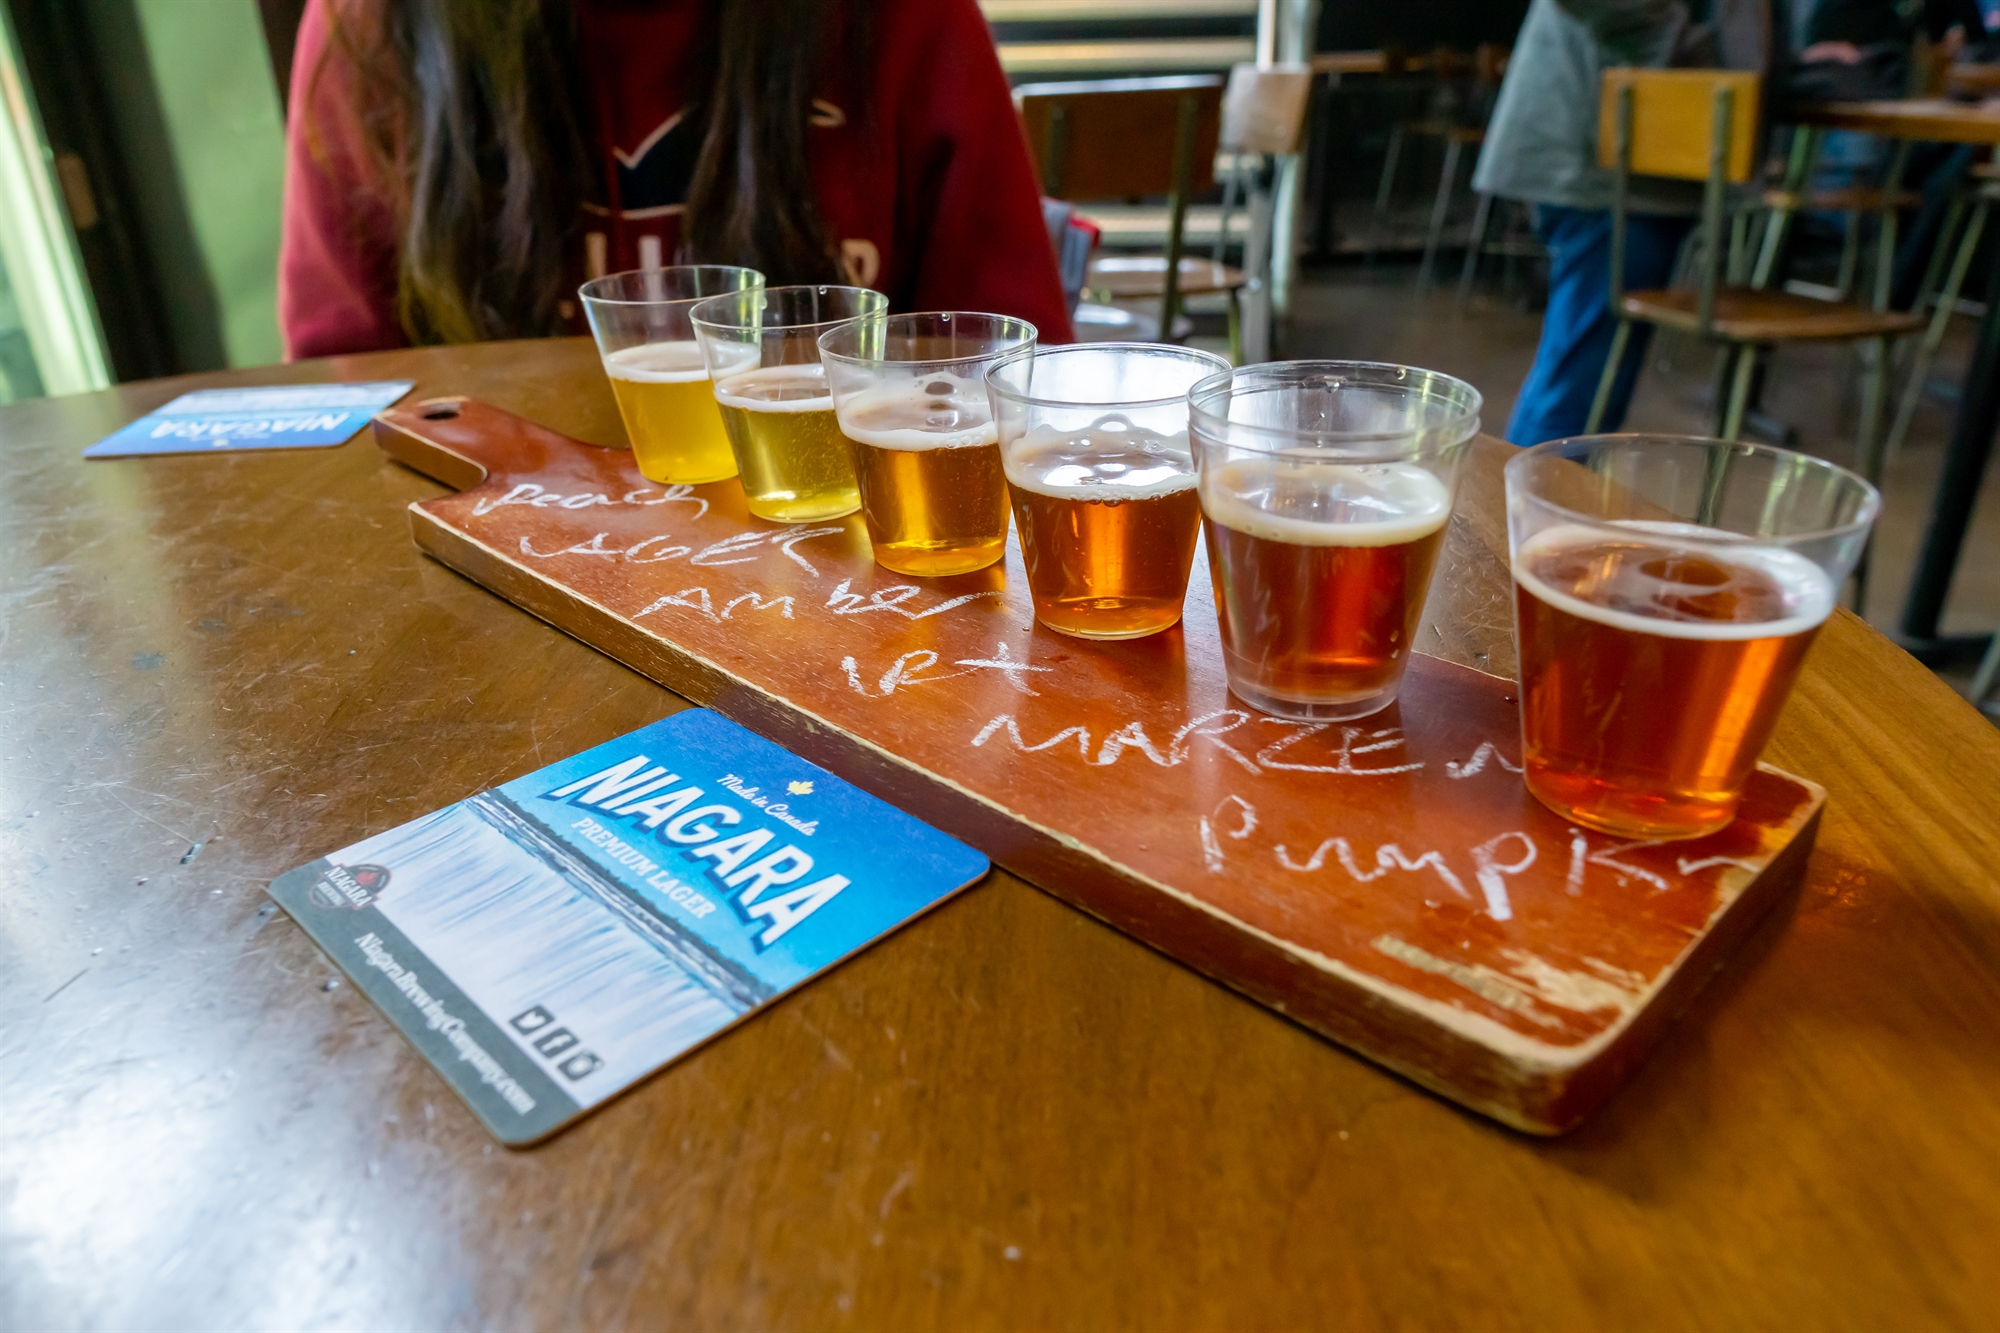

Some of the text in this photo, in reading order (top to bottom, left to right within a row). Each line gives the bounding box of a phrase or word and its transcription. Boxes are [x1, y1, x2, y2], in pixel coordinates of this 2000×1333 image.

[150, 411, 351, 439] NIAGARA
[717, 773, 819, 836] Made in Canada
[542, 753, 853, 948] NIAGARA
[570, 817, 717, 919] PREMIUM LAGER
[323, 866, 373, 908] NIAGARA
